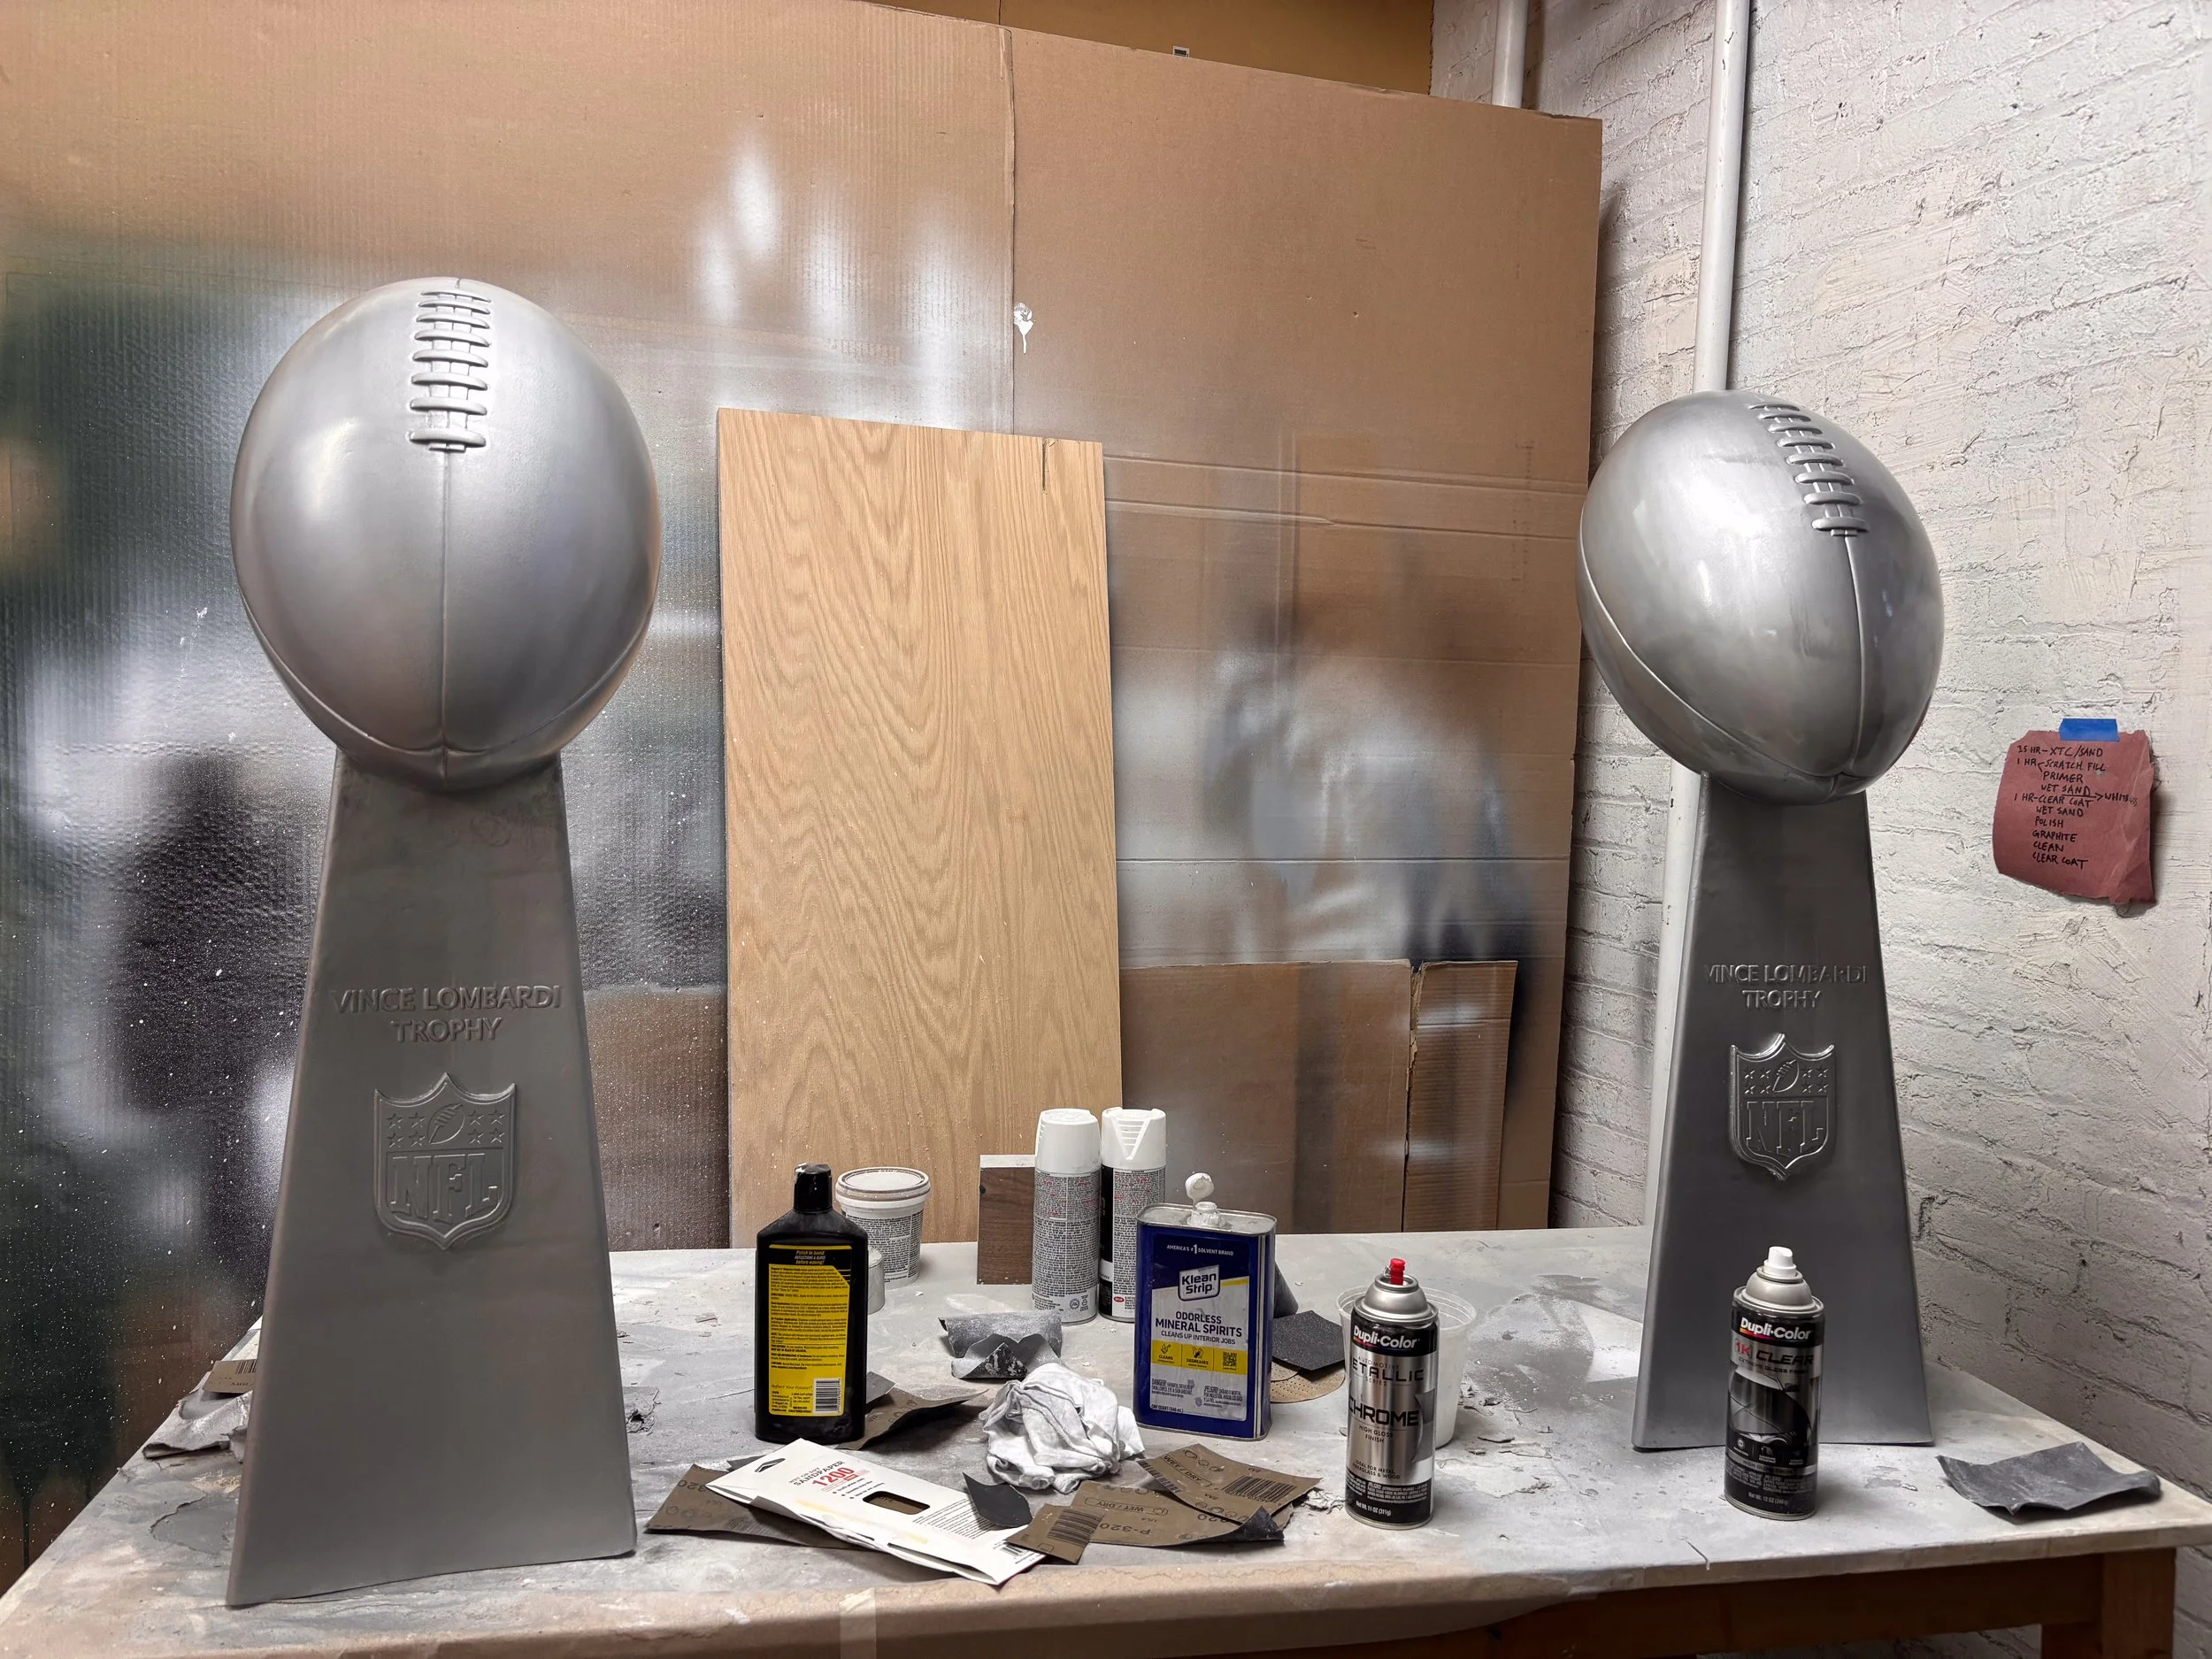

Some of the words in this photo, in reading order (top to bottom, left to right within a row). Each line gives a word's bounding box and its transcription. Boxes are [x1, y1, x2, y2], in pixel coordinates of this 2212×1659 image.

[2045, 760, 2083, 770] SCRATCH
[2087, 762, 2106, 772] FILL
[2043, 772, 2083, 783] PRIMER
[2062, 785, 2091, 796] SAND
[2070, 797, 2093, 808] COAT
[2036, 806, 2054, 815] WET
[2057, 808, 2084, 818] SAND
[2035, 816, 2063, 827] POLISH
[2032, 830, 2078, 842] GRAPHITE
[2033, 841, 2063, 852] CLEAN
[2032, 852, 2058, 864] CLEAR
[2062, 857, 2089, 870] COAT
[1703, 964, 1759, 984] VINCE
[1763, 964, 1867, 984] LOMBARDI
[332, 987, 416, 1013] VINCE
[423, 984, 563, 1012] LOMBARDI
[1741, 989, 1821, 1010] TROPHY
[390, 1017, 503, 1043] TROPHY
[1745, 1100, 1825, 1157] NFL
[387, 1153, 503, 1225] NFL
[1181, 1272, 1217, 1285] Klean
[1186, 1283, 1212, 1294] Strip
[1175, 1310, 1222, 1325] ODORLESS
[1155, 1317, 1201, 1333] MINERAL
[1202, 1324, 1242, 1337] SPIRITS
[1161, 1330, 1183, 1339] CLEANS
[1193, 1334, 1220, 1343] INTERIOR
[1736, 1340, 1751, 1356] 1K
[1755, 1349, 1814, 1366] CLEAR
[1352, 1357, 1425, 1382] ETALLIC
[1348, 1394, 1420, 1426] CHROME
[1365, 1434, 1385, 1443] FINISH
[1373, 1429, 1394, 1438] GLOSS
[793, 1460, 845, 1486] SANDPAPER
[1163, 1455, 1180, 1469] WET
[1185, 1471, 1202, 1482] DRY
[812, 1467, 855, 1486] 1200
[1099, 1523, 1151, 1535] P-320
